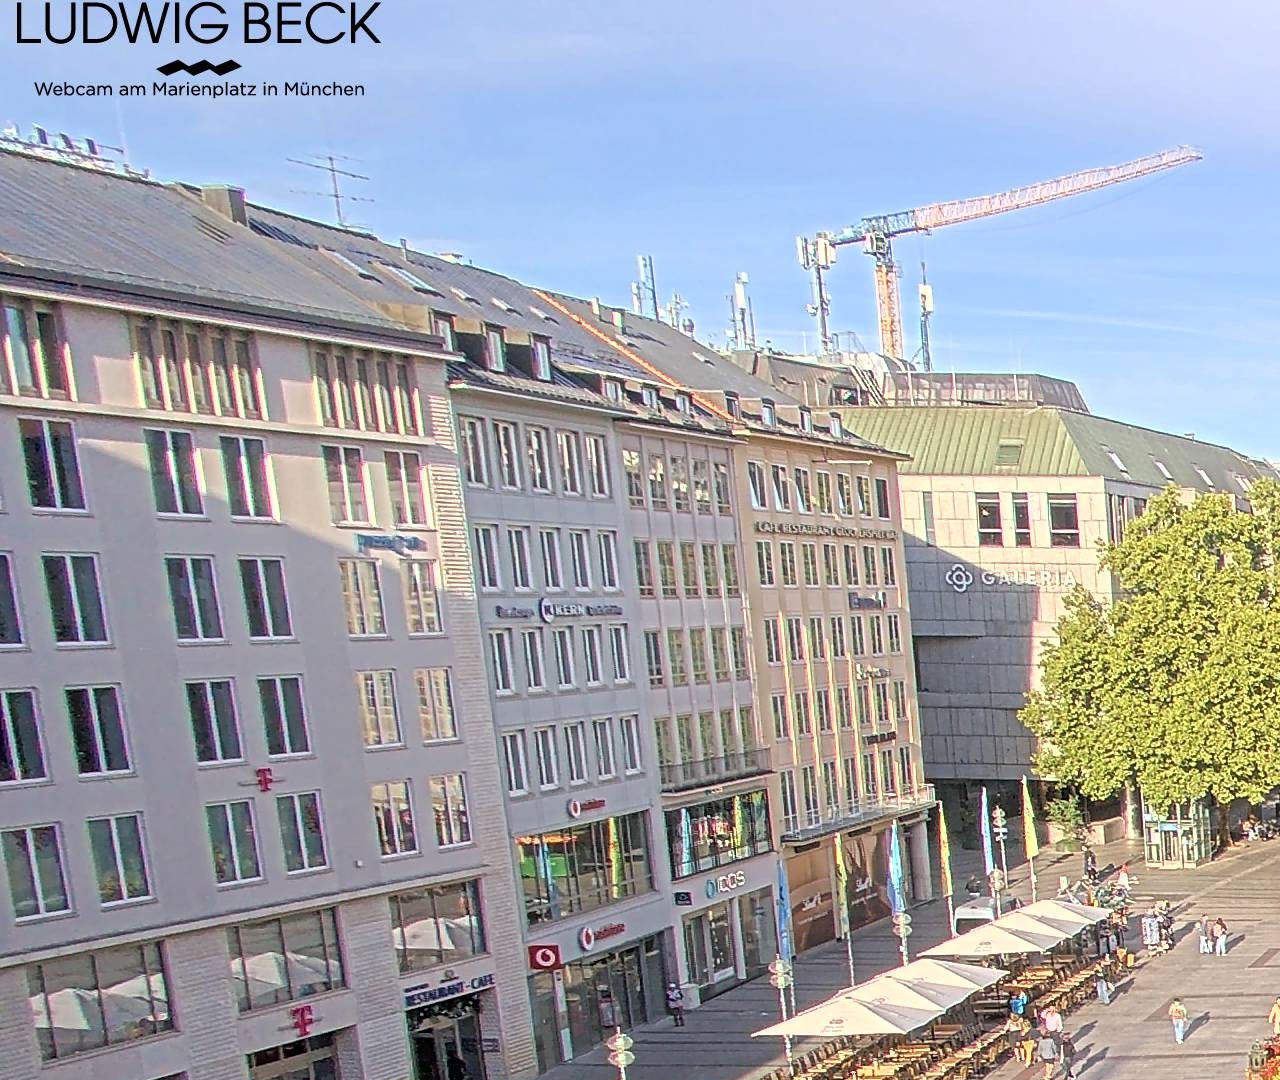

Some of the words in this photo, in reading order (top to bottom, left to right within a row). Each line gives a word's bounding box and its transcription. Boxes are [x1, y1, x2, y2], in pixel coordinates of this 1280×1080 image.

[981, 569, 1076, 586] GALERIA
[555, 603, 585, 616] KERN
[405, 981, 464, 1007] RESTAURANT
